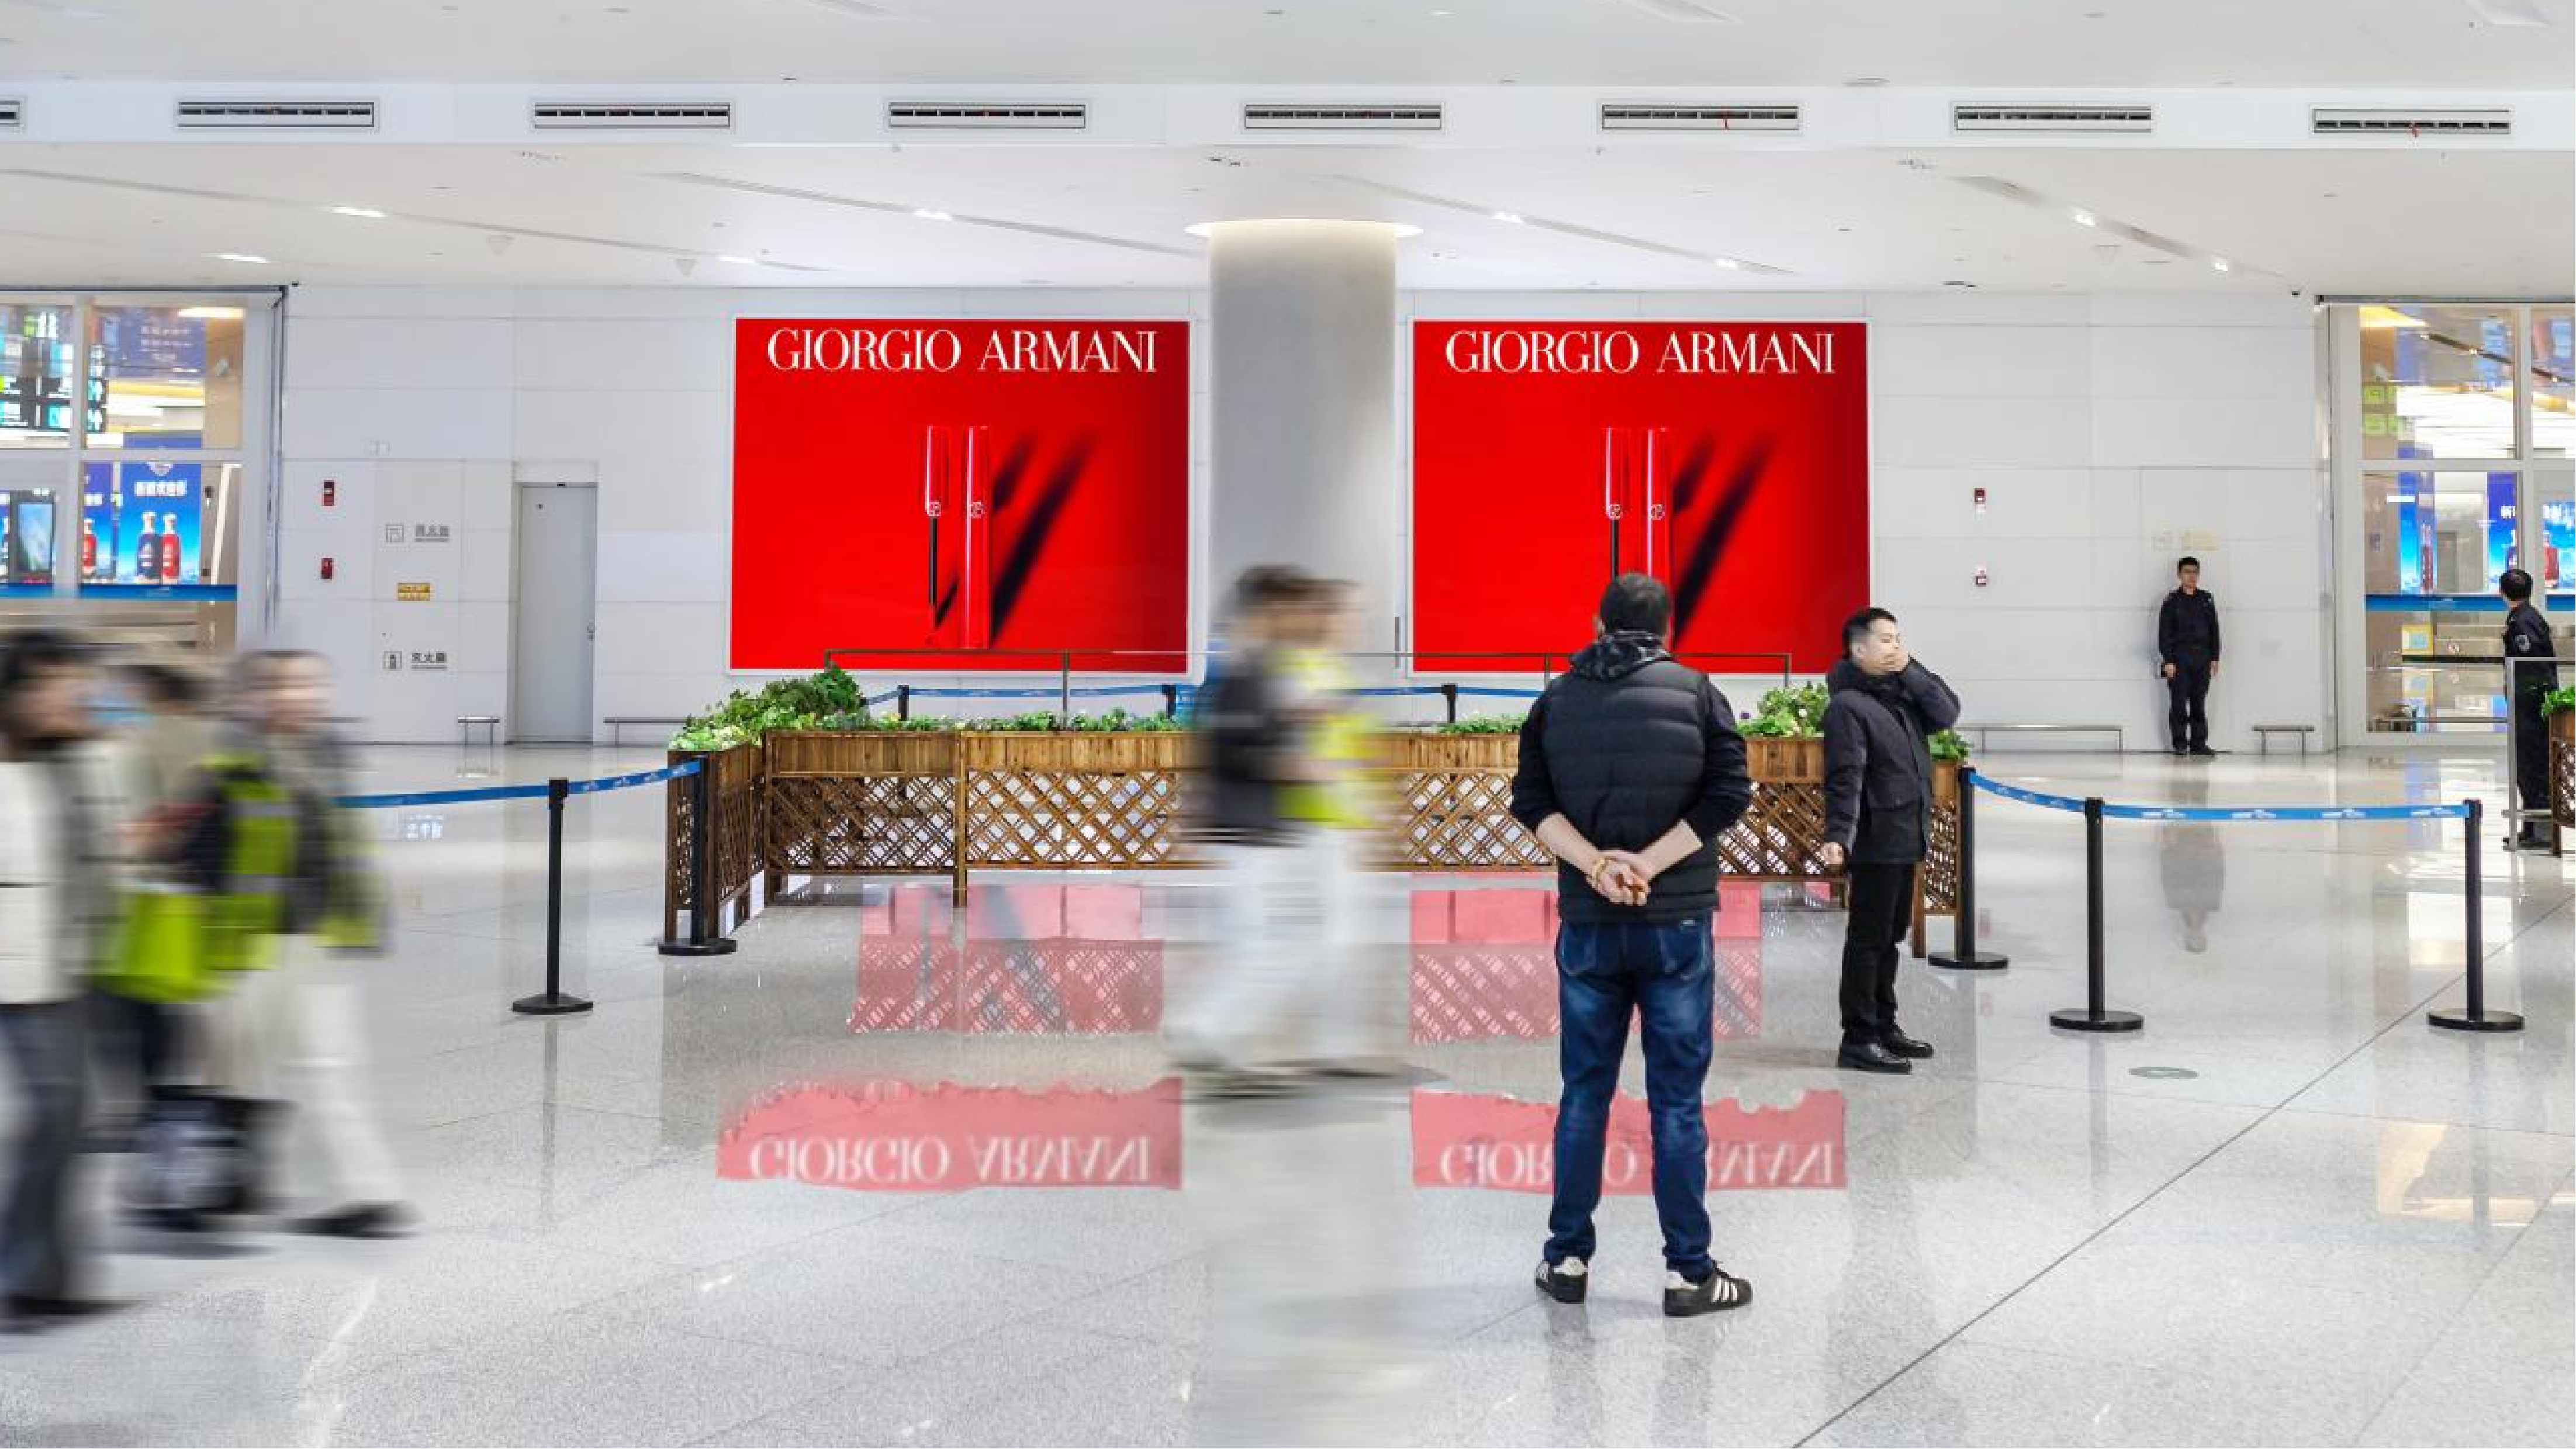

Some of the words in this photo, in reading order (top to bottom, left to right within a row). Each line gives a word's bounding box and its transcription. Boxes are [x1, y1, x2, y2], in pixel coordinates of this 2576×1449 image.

[767, 328, 962, 372] GIORGIO
[977, 330, 1157, 372] ARMANI
[1445, 330, 1640, 374] GIORGIO
[1657, 332, 1835, 374] ARMANI
